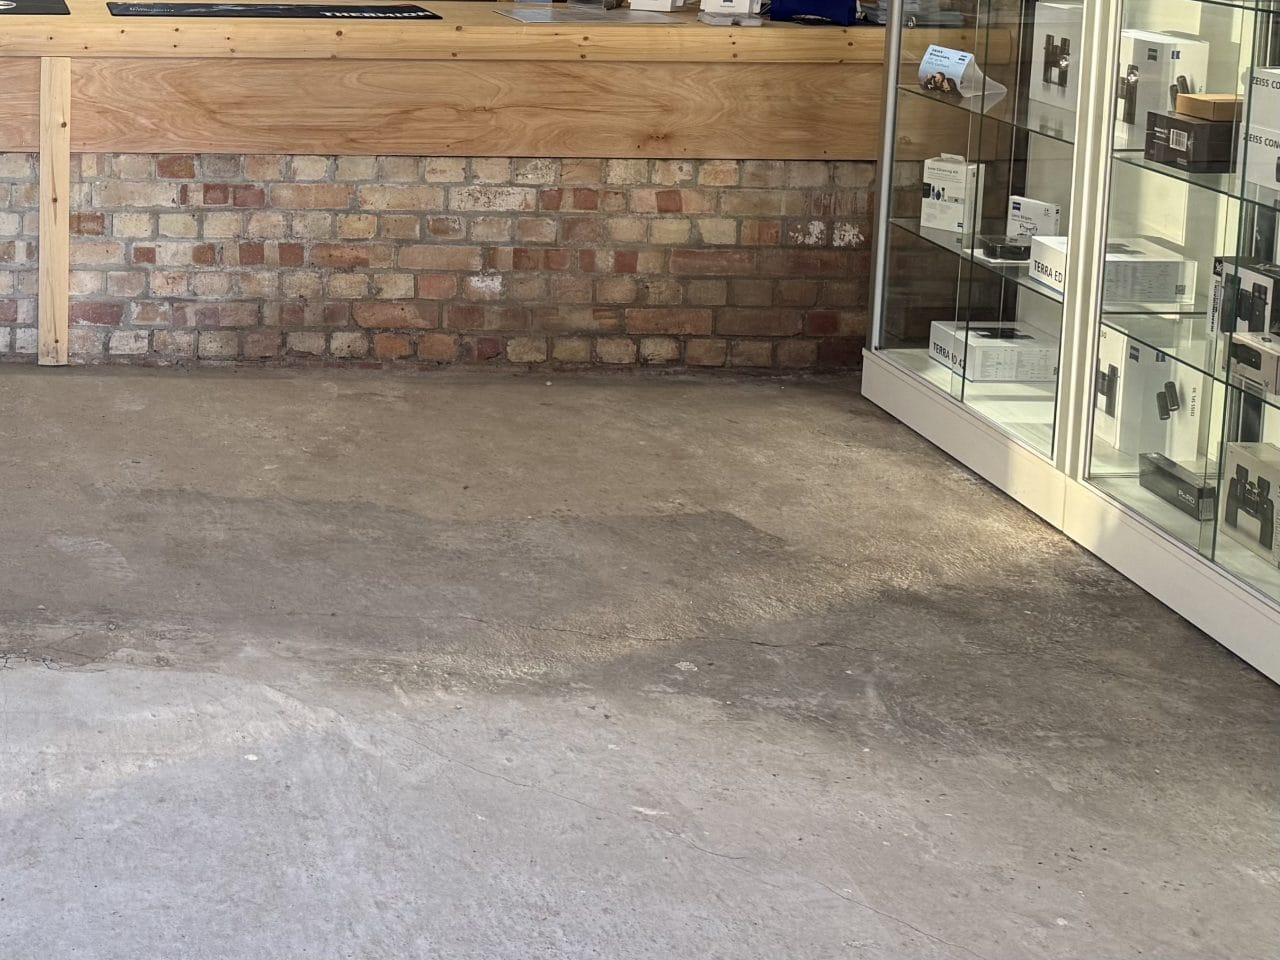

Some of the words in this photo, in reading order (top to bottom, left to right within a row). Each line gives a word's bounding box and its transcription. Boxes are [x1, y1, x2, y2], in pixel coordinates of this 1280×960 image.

[1251, 77, 1269, 87] ZEISS
[1034, 260, 1053, 278] TERRA
[1054, 271, 1063, 283] ED
[933, 342, 950, 361] TERRA
